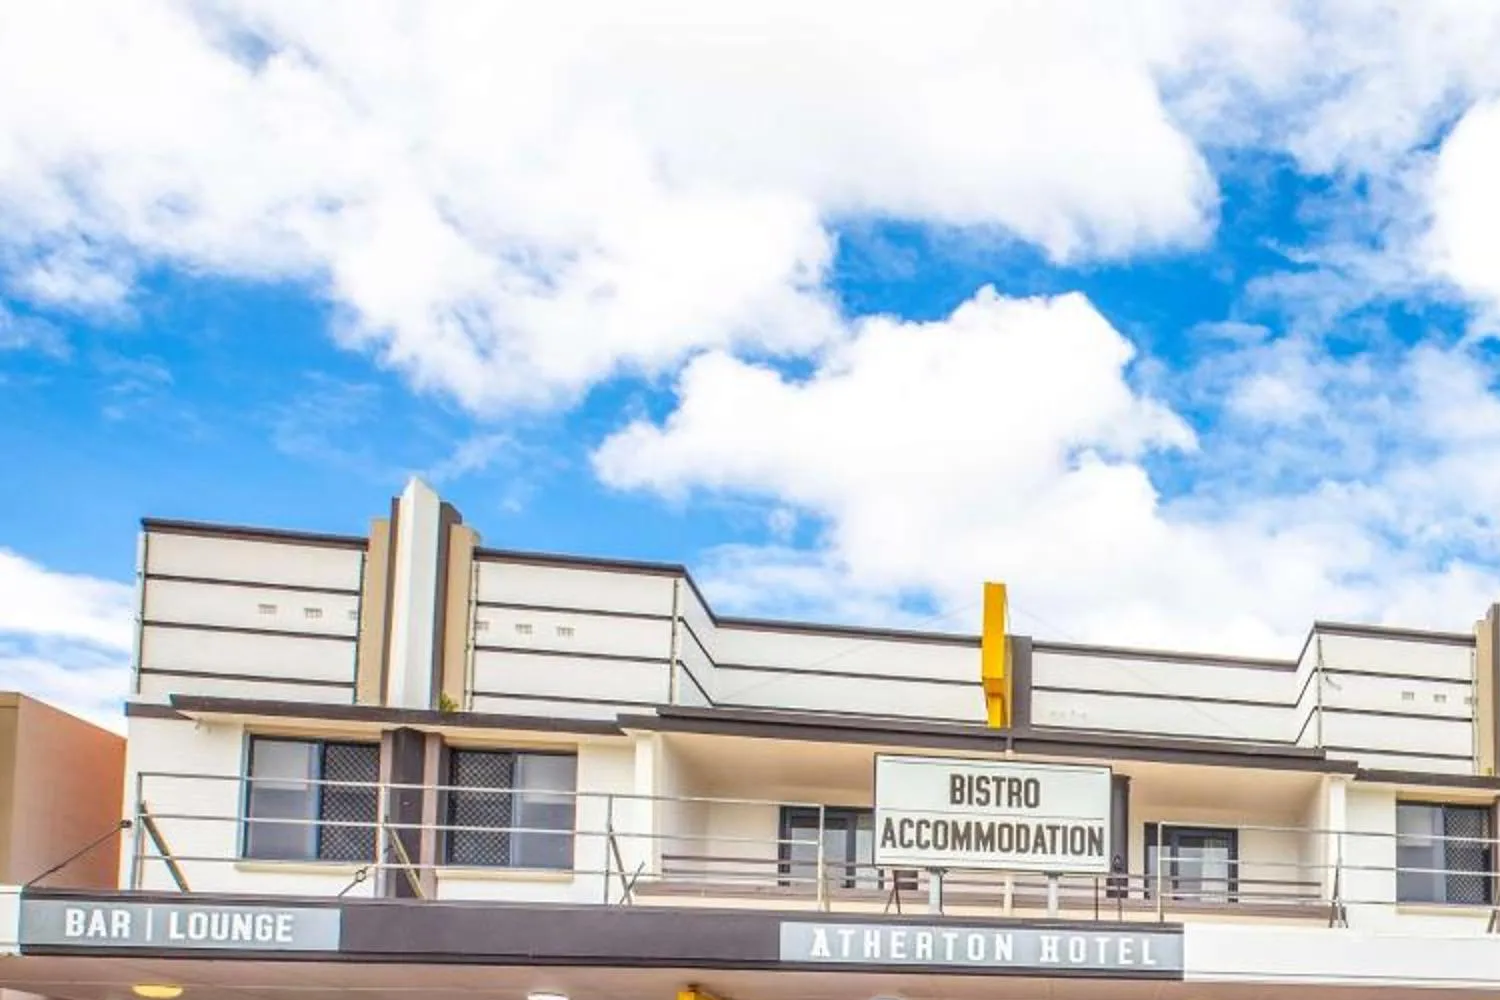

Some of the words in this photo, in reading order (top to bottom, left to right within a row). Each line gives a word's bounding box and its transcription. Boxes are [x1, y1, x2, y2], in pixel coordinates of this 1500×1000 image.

[949, 773, 1041, 808] BISTRO
[880, 817, 1104, 856] ACCOMMODATION
[65, 908, 132, 939] BAR
[168, 911, 293, 943] LOUNGE
[809, 927, 1013, 962] ATHERTON
[1038, 934, 1157, 965] HOTEL
